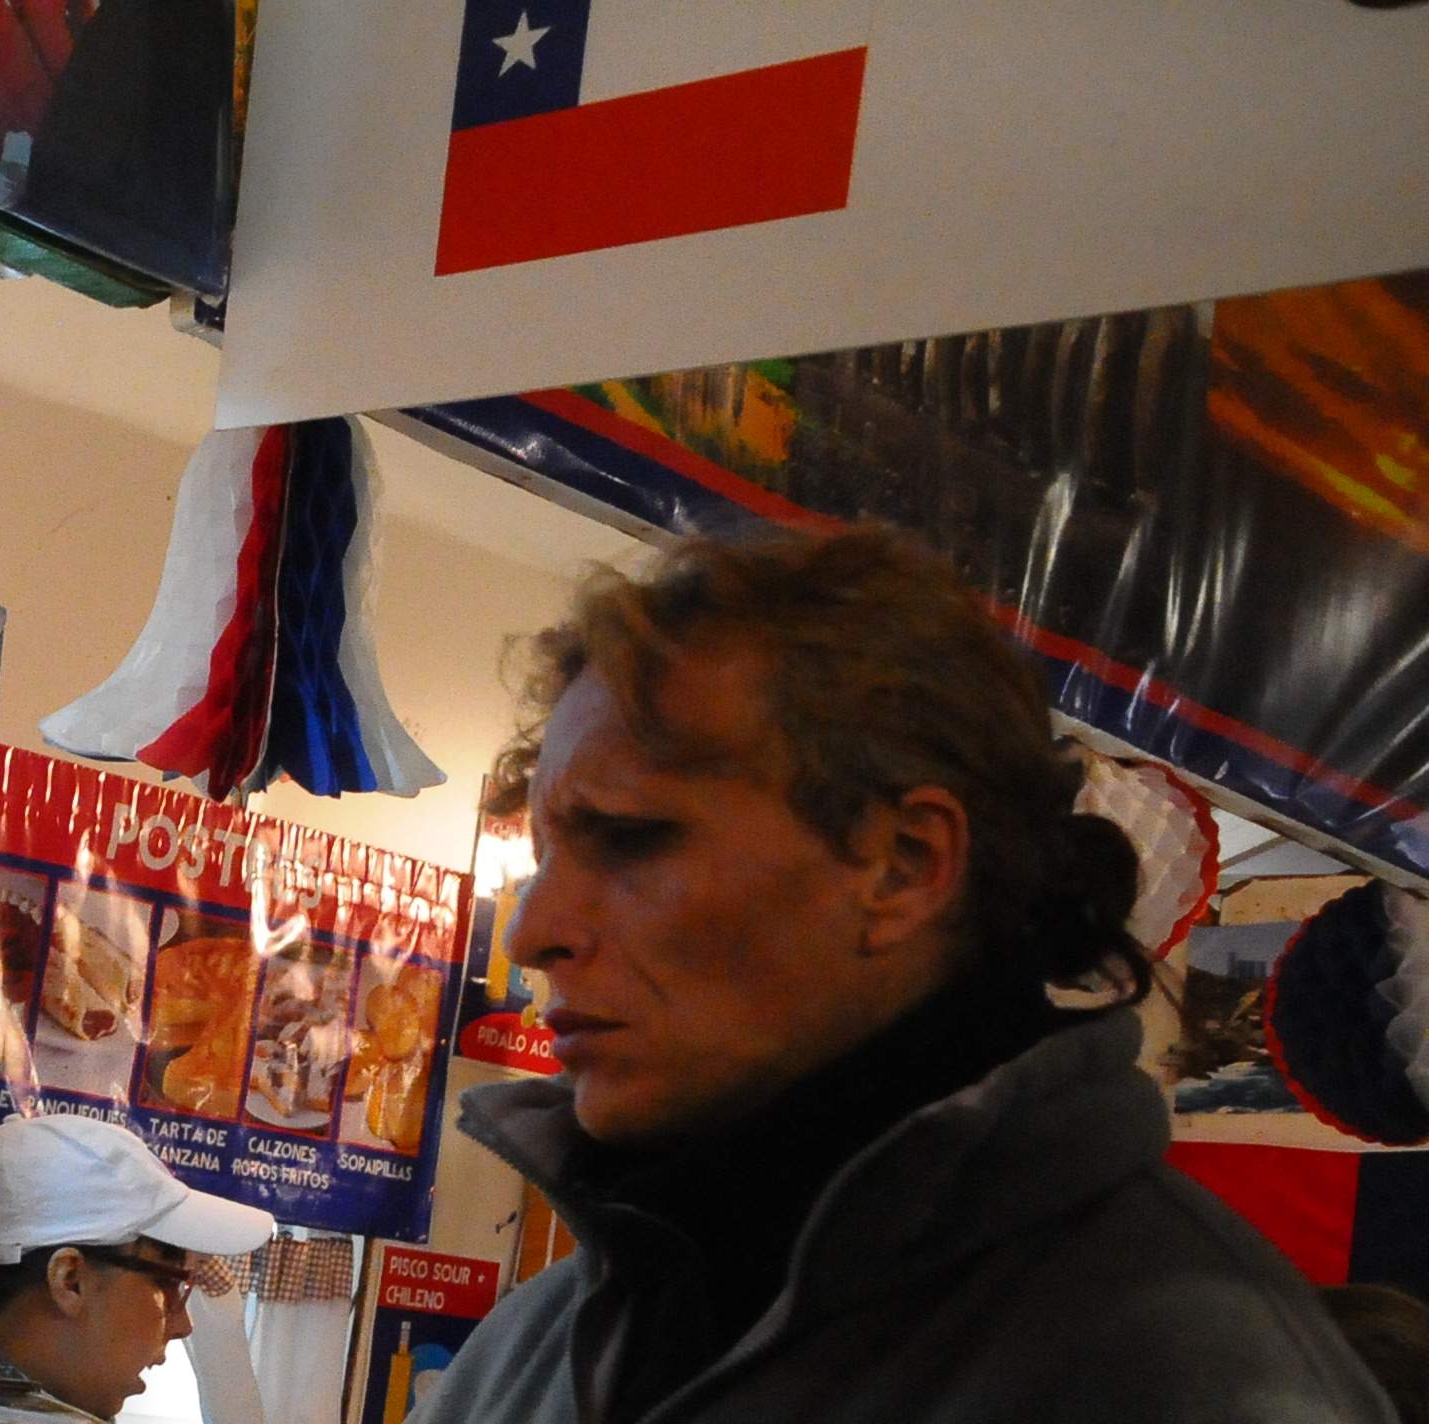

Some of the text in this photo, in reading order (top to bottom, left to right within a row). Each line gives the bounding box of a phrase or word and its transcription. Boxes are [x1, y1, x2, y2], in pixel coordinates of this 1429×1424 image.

[529, 1039, 556, 1059] AQ
[149, 1118, 228, 1148] TARTA DE
[248, 1136, 317, 1164] CALZONES
[281, 1165, 330, 1190] FRITOS
[339, 1152, 413, 1182] SOPAIPILLAS
[389, 1256, 471, 1285] PISCO SOUR
[385, 1285, 445, 1311] CHILENO
